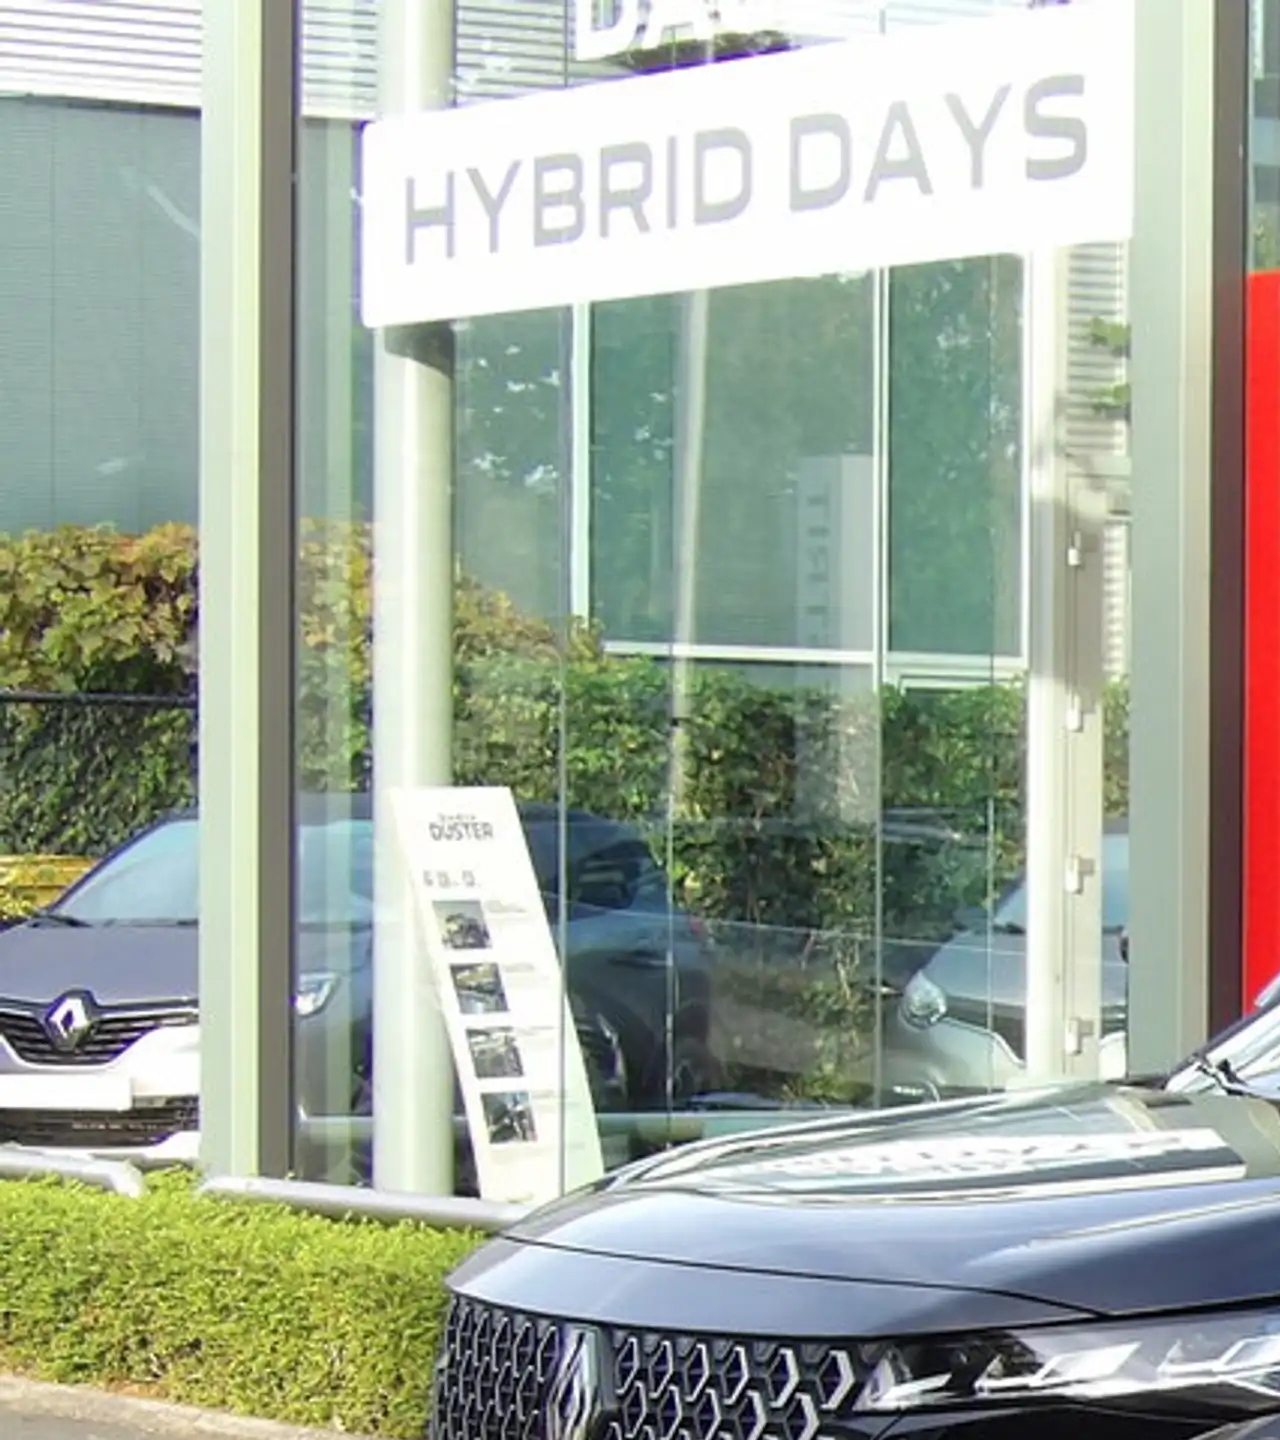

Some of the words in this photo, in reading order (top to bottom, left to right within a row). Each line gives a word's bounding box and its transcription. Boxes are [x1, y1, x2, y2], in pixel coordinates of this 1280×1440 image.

[405, 125, 753, 265] HYBRID
[788, 73, 1088, 214] DAYS
[429, 821, 493, 841] DUSTER
